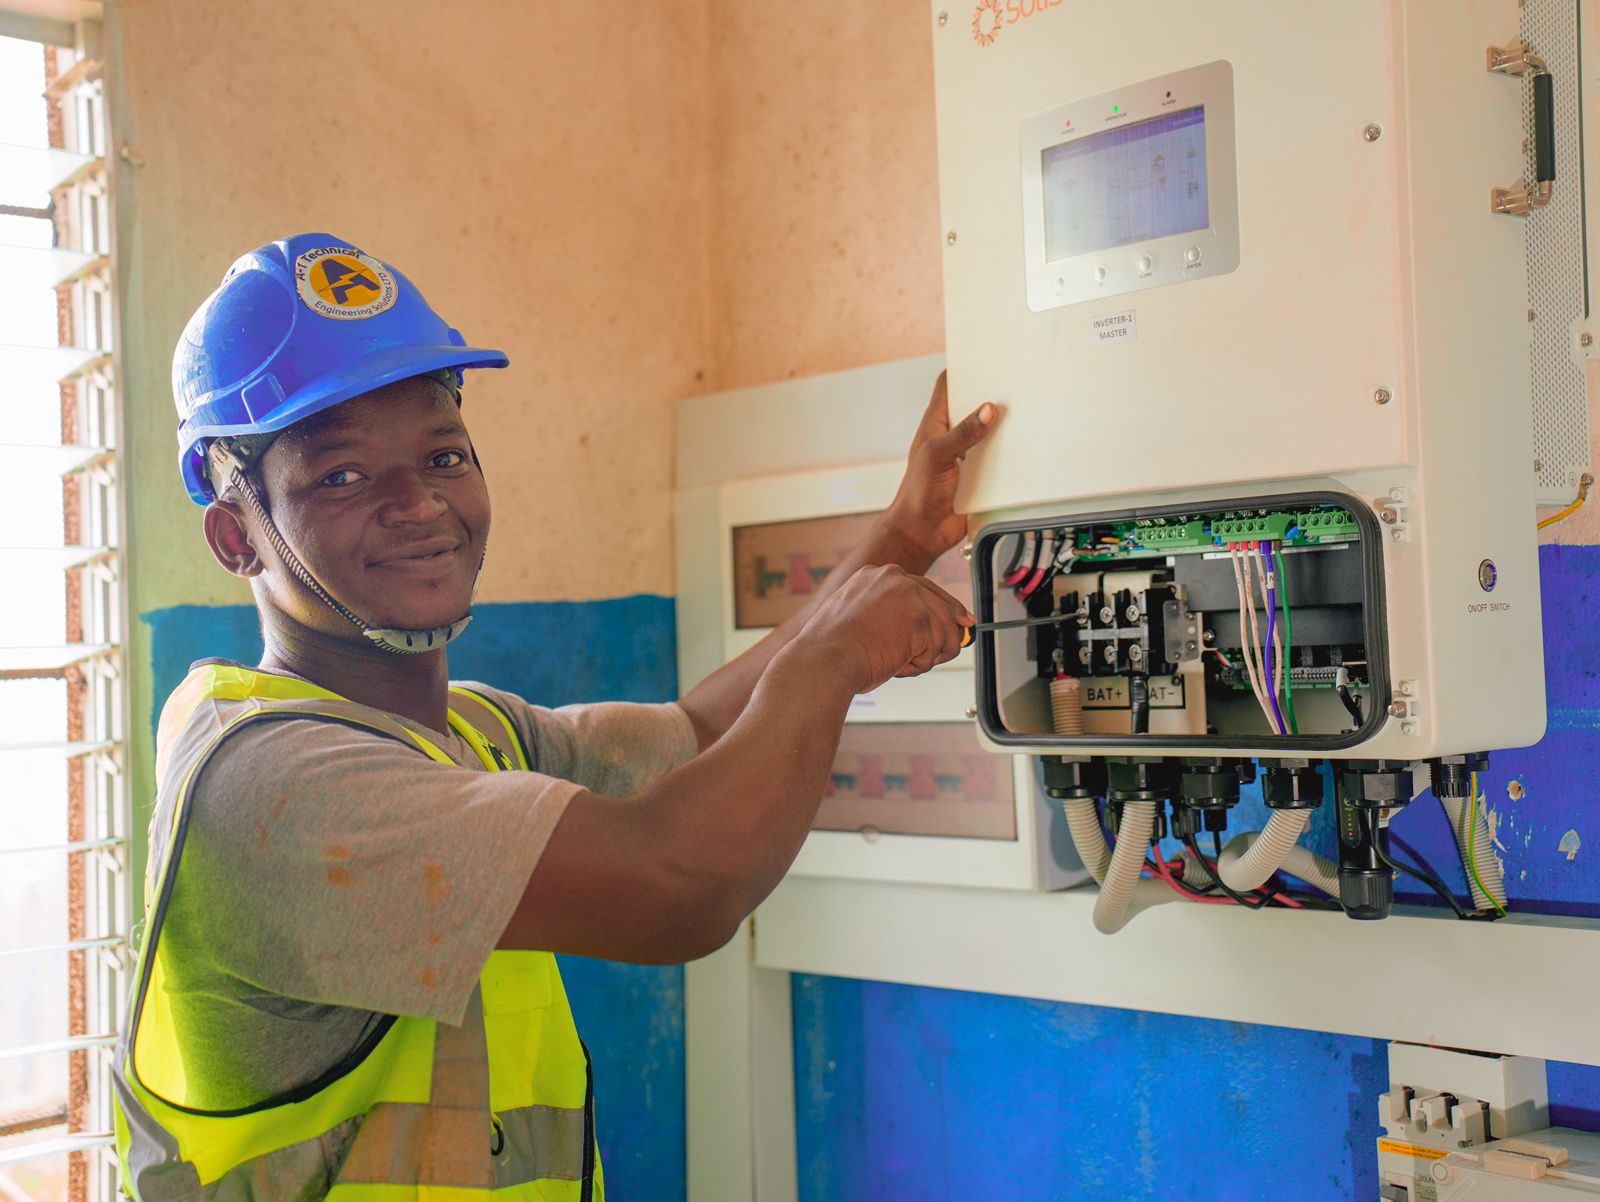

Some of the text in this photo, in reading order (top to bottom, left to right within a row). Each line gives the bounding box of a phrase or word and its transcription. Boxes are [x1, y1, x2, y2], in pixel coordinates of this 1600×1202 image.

[314, 272, 393, 316] Engineering Solutions LTD
[1093, 314, 1133, 329] INVERTER-1
[1099, 328, 1128, 340] MASTER
[1489, 602, 1510, 612] SWITCH
[1087, 687, 1122, 701] BAT+
[1149, 687, 1175, 700] AT-
